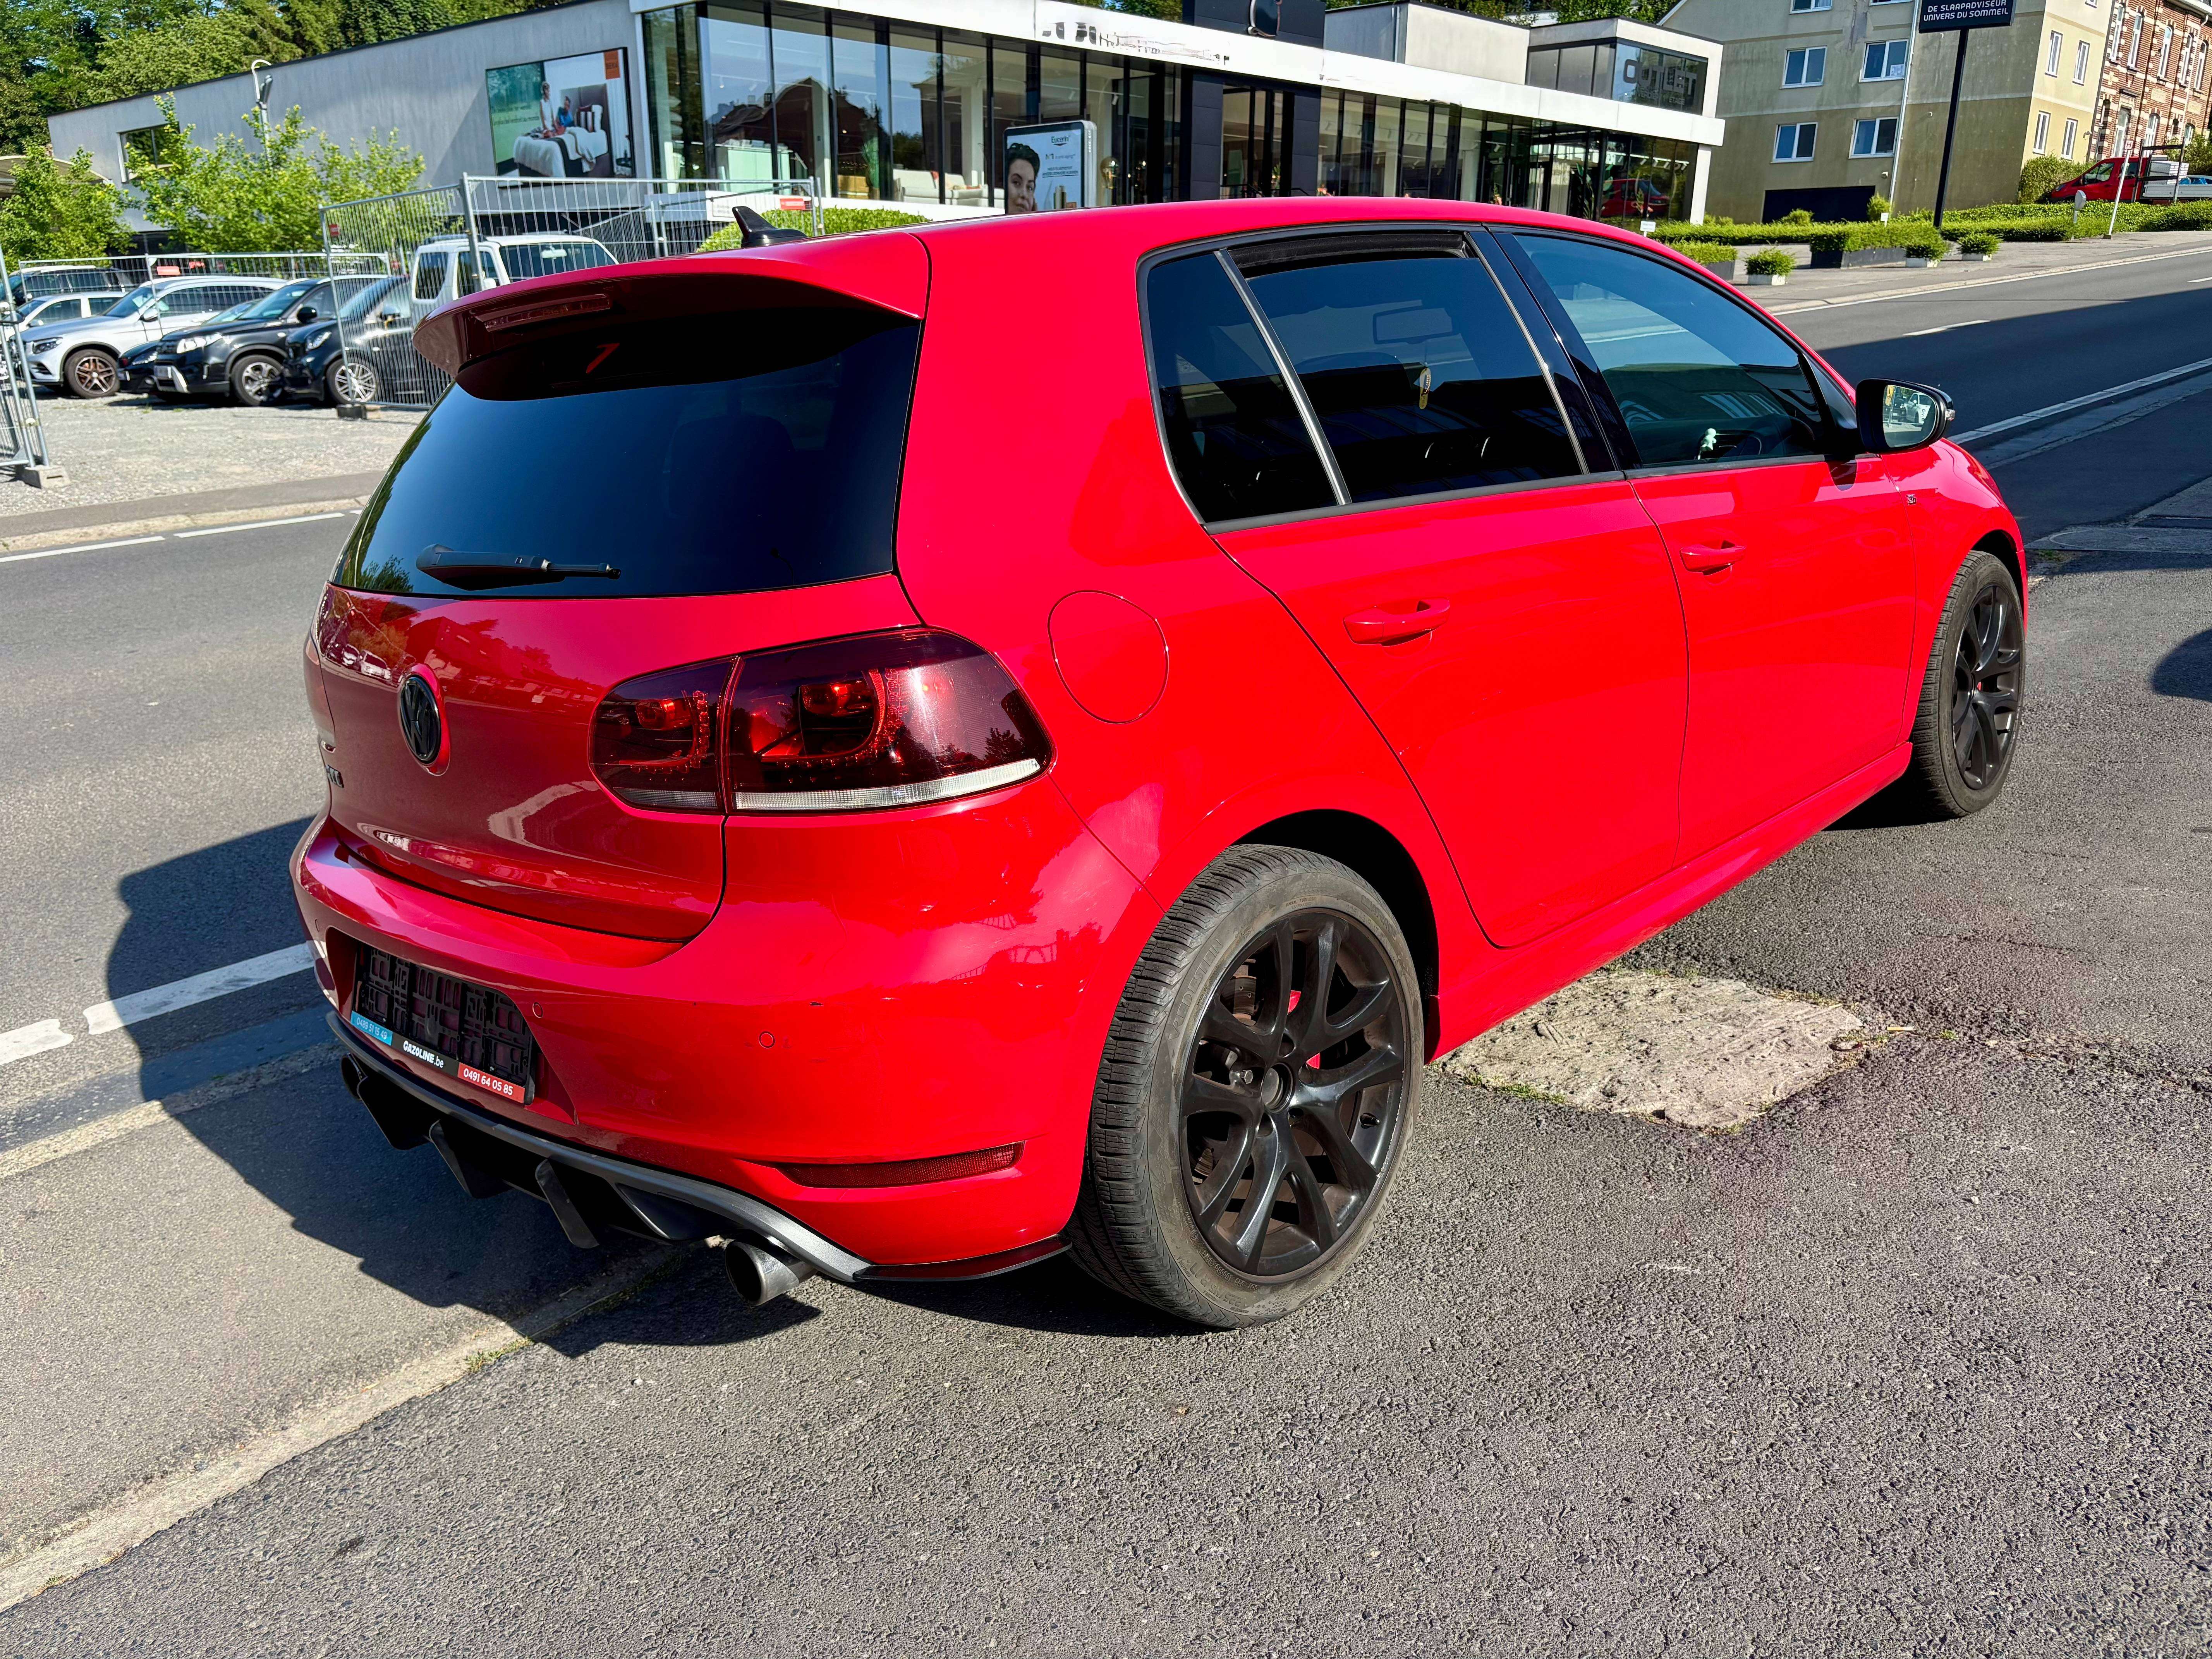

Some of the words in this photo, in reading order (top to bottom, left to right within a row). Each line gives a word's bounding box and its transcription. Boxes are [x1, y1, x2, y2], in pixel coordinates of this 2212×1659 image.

[1923, 12, 1955, 21] UNIVERS
[1969, 8, 2009, 17] SOMMEIL
[1940, 0, 2006, 11] SLAAPADVISEUR
[1623, 59, 1697, 95] OUTLET
[1167, 938, 1223, 1041] VREDESTEIN
[357, 1017, 368, 1030] 0489
[368, 1023, 374, 1033] 51
[375, 1027, 380, 1037] 15
[381, 1031, 387, 1040] 49
[403, 1040, 444, 1068] GAZOLINE.be
[464, 1068, 480, 1082] 0491
[481, 1075, 491, 1087] 64
[492, 1080, 502, 1091] 05
[503, 1084, 513, 1096] 85
